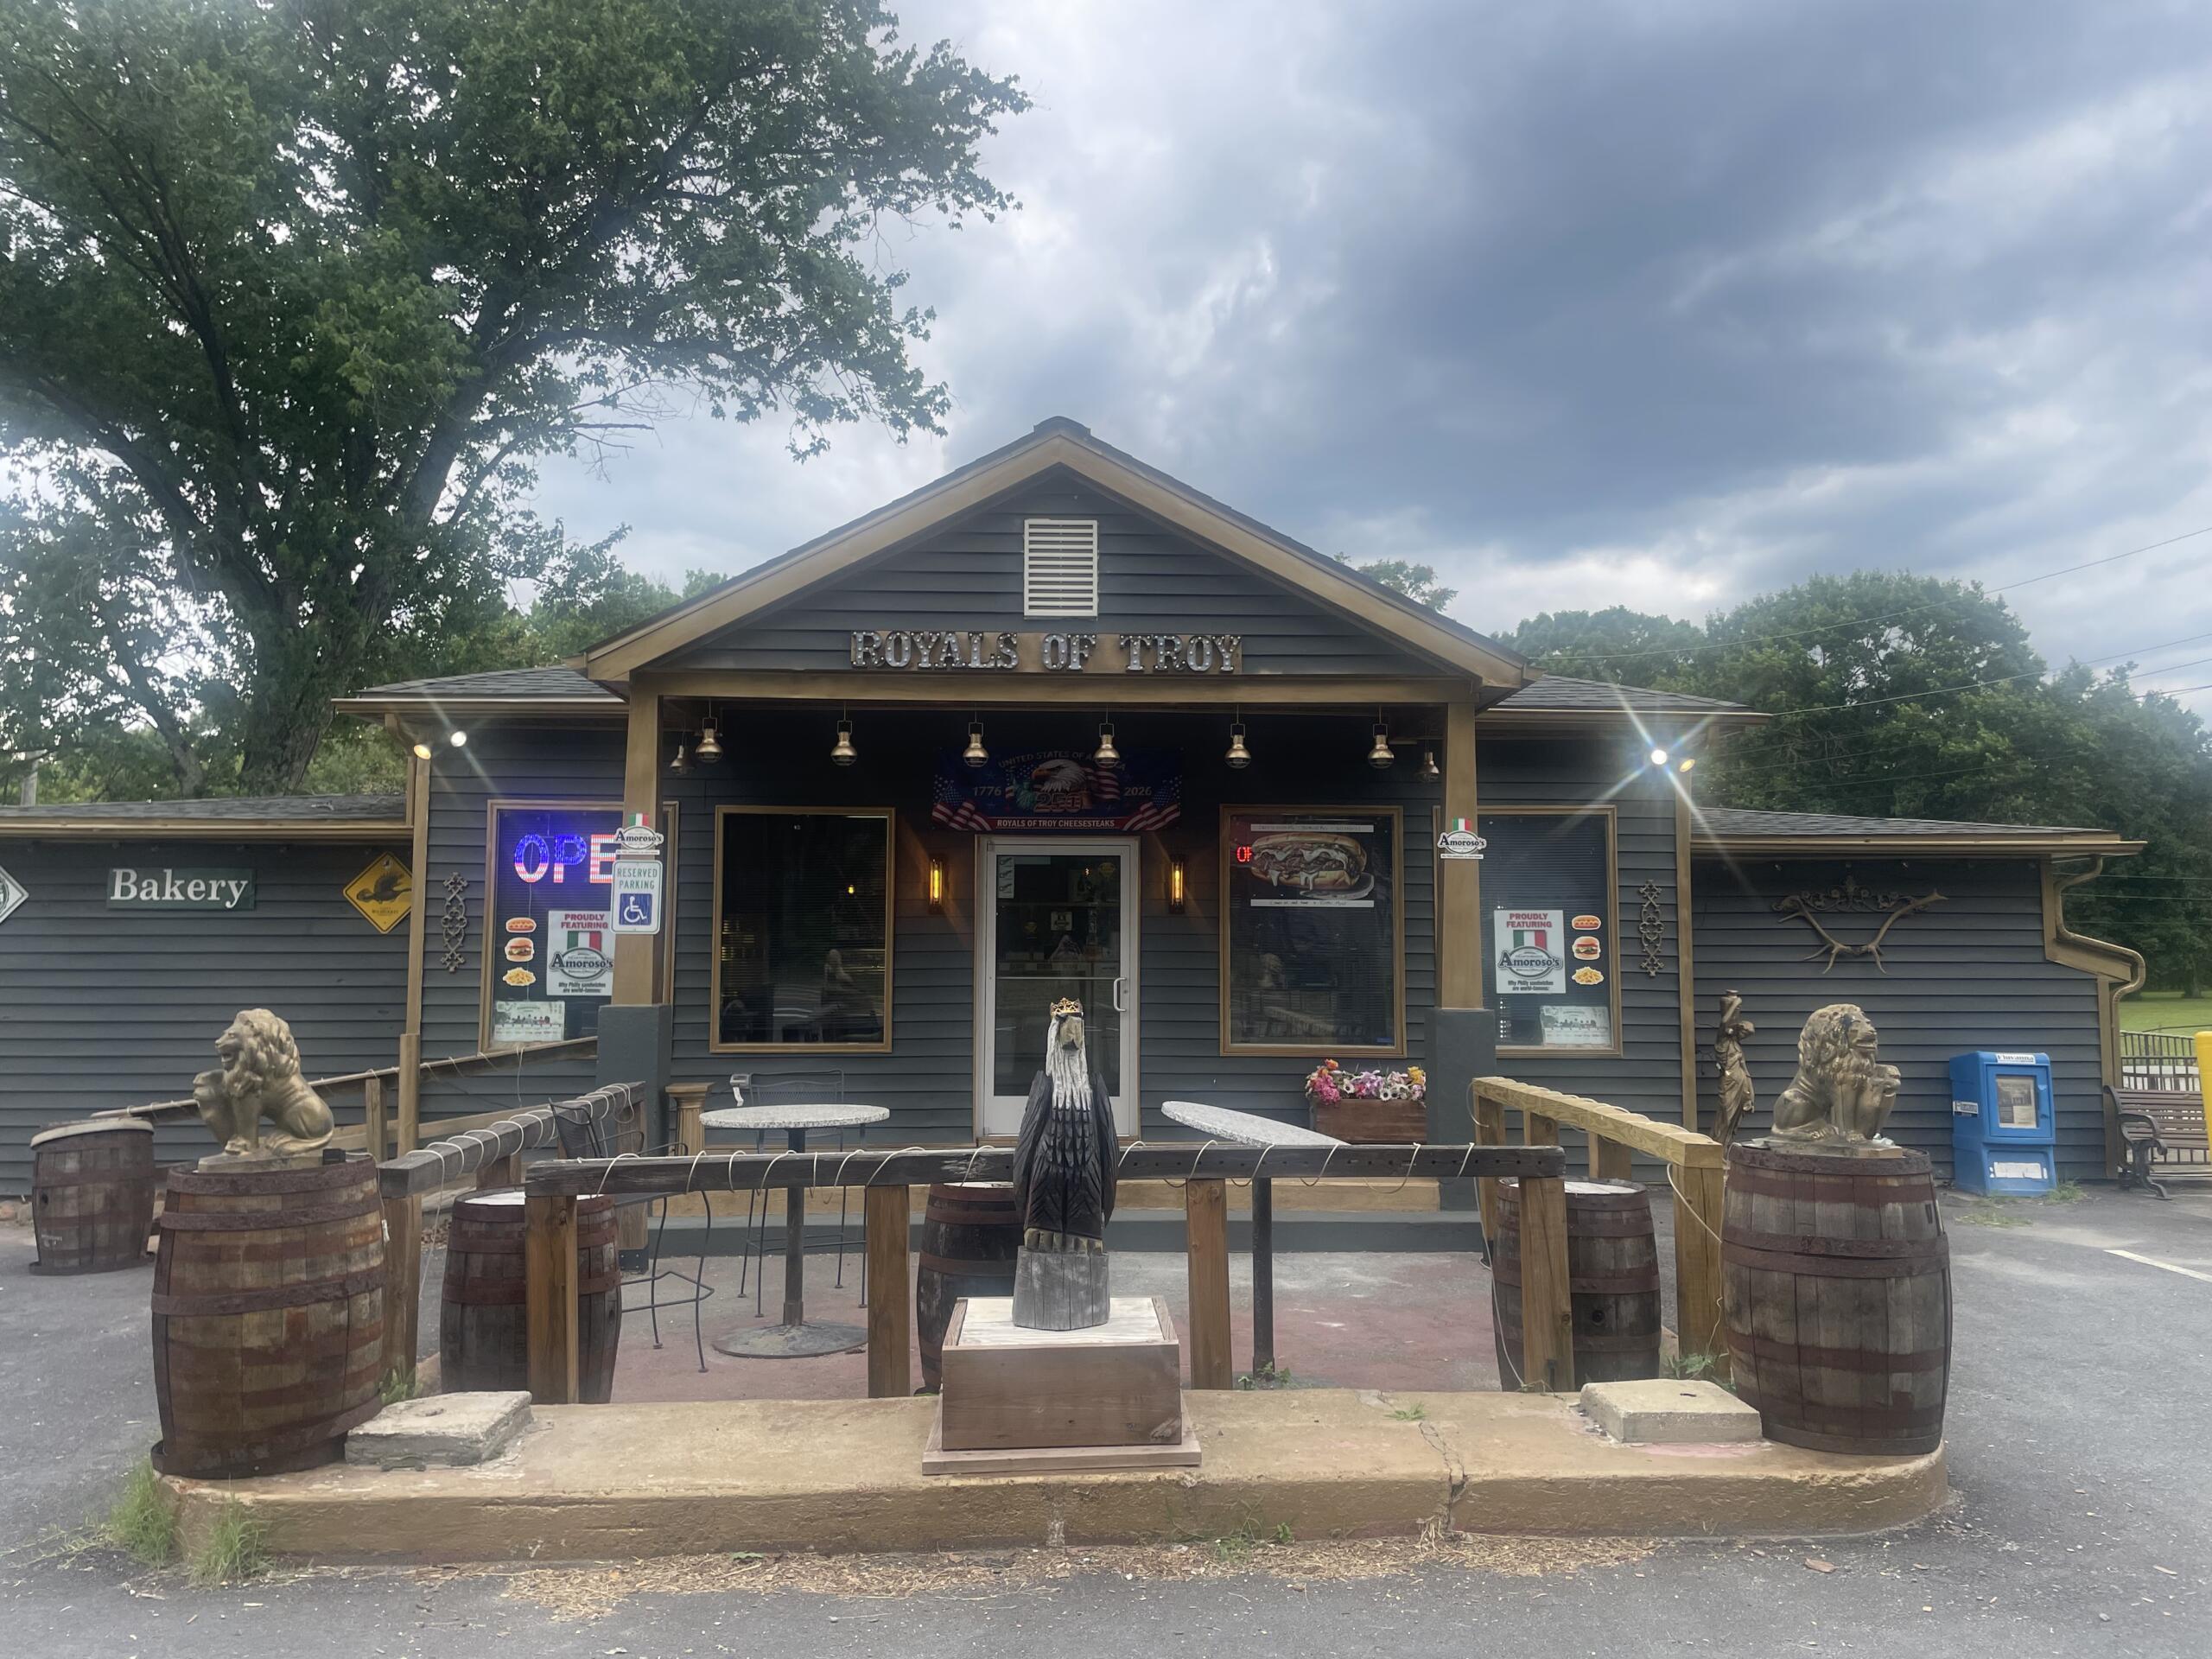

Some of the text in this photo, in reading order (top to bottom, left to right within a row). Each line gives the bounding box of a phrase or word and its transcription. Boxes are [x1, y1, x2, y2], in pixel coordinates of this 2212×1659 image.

[851, 631, 1242, 672] ROYALS OF TROY
[999, 750, 1083, 768] UNITED STATES OF
[973, 786, 1001, 796] 1776
[1124, 786, 1152, 796] 2026
[997, 819, 1026, 828] ROYALS
[1058, 819, 1115, 828] CHEESESTEAKS
[615, 830, 662, 842] Amoroso's
[1440, 835, 1484, 846] Amoroso's
[514, 834, 614, 883] OPE
[617, 868, 658, 878] RESERVED
[110, 868, 248, 909] Bakery
[619, 880, 655, 890] PARKING
[551, 953, 613, 969] Amoroso's
[1499, 952, 1560, 967] Amoroso's
